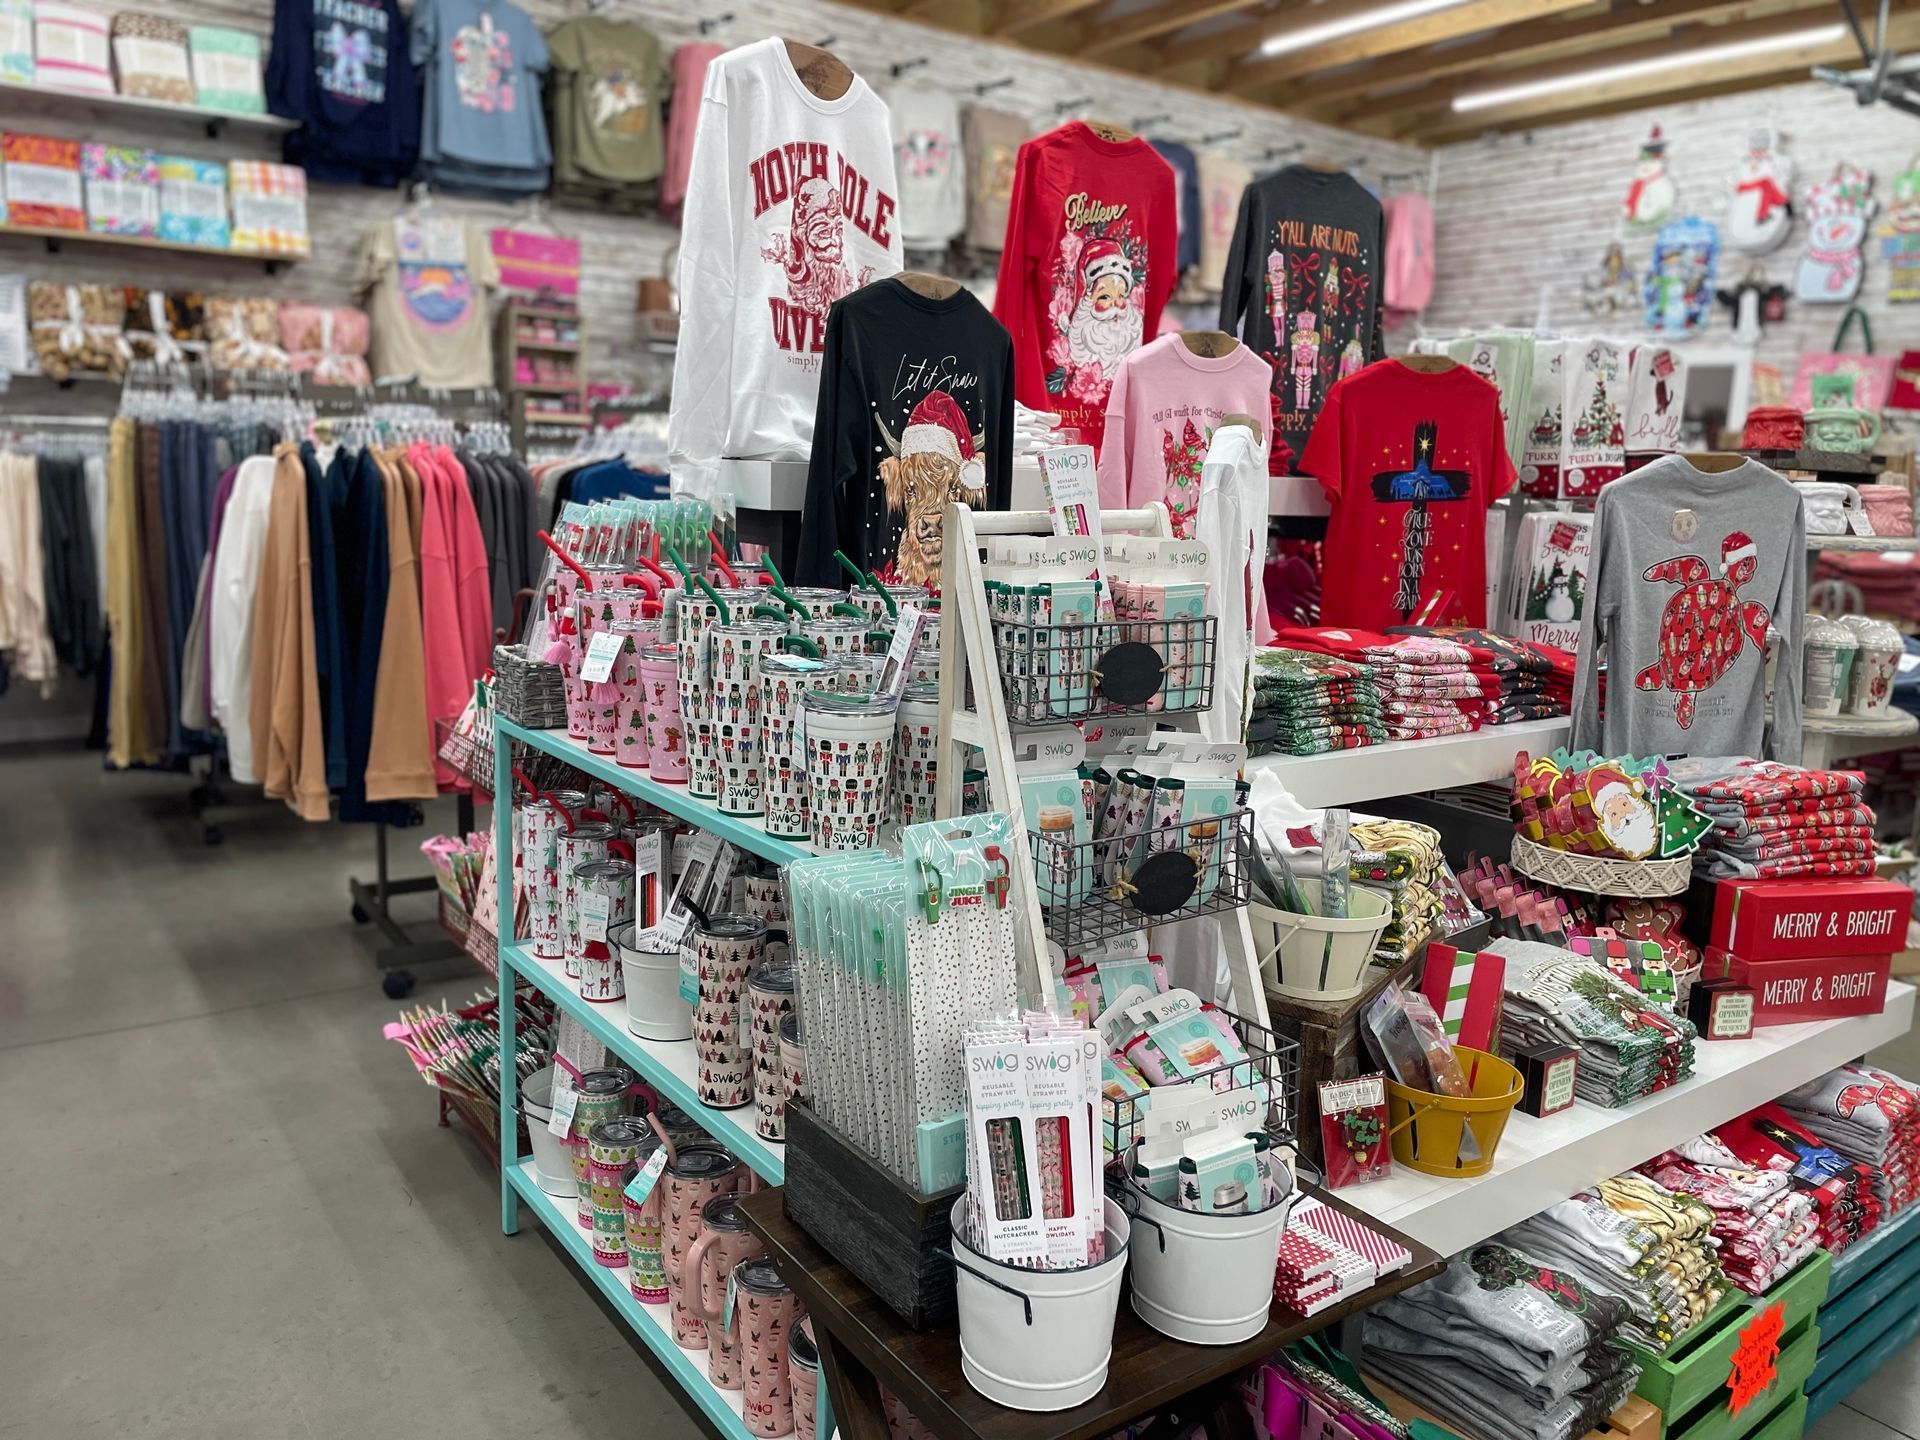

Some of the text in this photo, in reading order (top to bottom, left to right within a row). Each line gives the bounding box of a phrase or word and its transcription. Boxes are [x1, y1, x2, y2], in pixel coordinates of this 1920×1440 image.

[836, 150, 896, 251] OLE
[1064, 191, 1128, 232] Believe
[1309, 223, 1333, 250] ARE
[1332, 228, 1360, 258] NUTS
[787, 354, 821, 370] simply
[892, 354, 978, 400] Let it Snow
[1048, 453, 1079, 470] swig
[1069, 546, 1097, 563] swig
[1181, 550, 1207, 566] swig
[1531, 622, 1580, 651] Merry
[596, 723, 615, 733] swi
[1044, 741, 1074, 756] swig
[1207, 752, 1237, 764] swig
[728, 785, 760, 799] swig
[770, 809, 801, 826] swig
[832, 830, 868, 845] swig
[948, 886, 985, 897] JINGLE
[951, 895, 983, 907] JUICE
[1772, 909, 1897, 939] MERRY & BRIGHT
[1113, 938, 1138, 950] swig
[1762, 971, 1876, 1006] MERRY & BRIGHT
[1161, 997, 1190, 1016] swig
[1718, 1009, 1749, 1019] OPINION
[972, 1050, 1019, 1072] swig
[1026, 1050, 1071, 1072] swig
[713, 1071, 743, 1084] swig
[1549, 1076, 1571, 1090] OPINION
[982, 1082, 1014, 1090] REUSABLE
[1003, 1099, 1025, 1109] pretty
[1029, 1099, 1074, 1111] ipping pretty
[1220, 1100, 1257, 1121] swig
[1175, 1120, 1192, 1133] sw
[994, 1231, 1039, 1240] NUTCRACKERS
[1003, 1224, 1028, 1232] CLASSIC
[746, 1398, 773, 1415] swig
[1556, 1411, 1573, 1426] YOUTH
